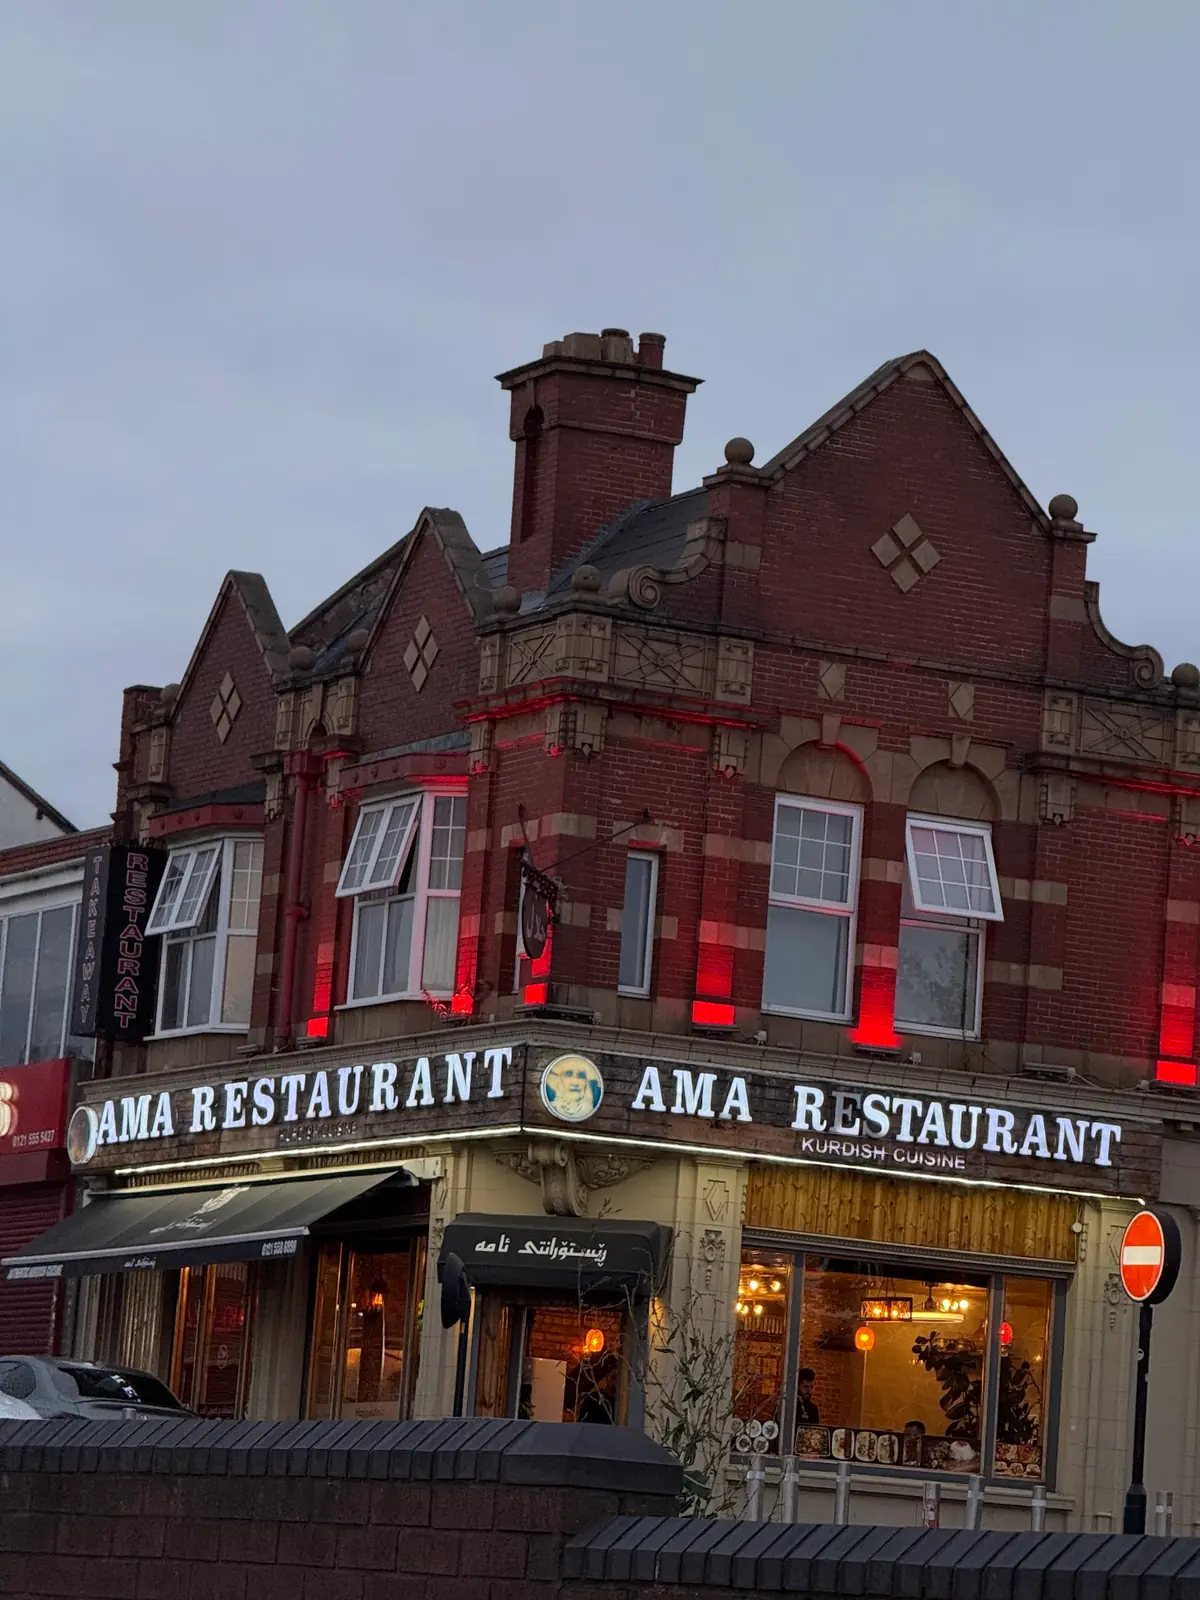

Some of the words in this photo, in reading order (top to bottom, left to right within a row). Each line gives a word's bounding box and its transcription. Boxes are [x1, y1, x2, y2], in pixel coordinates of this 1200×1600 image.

[80, 855, 103, 1024] TAKEAWAY
[113, 851, 149, 1028] RESTAURANT
[96, 1091, 175, 1145] AMA
[189, 1047, 513, 1133] RESTAURANT
[631, 1066, 752, 1122] AMA
[791, 1085, 1122, 1167] RESTAURANT
[801, 1136, 885, 1161] KURDISH
[893, 1147, 966, 1170] CUISINE
